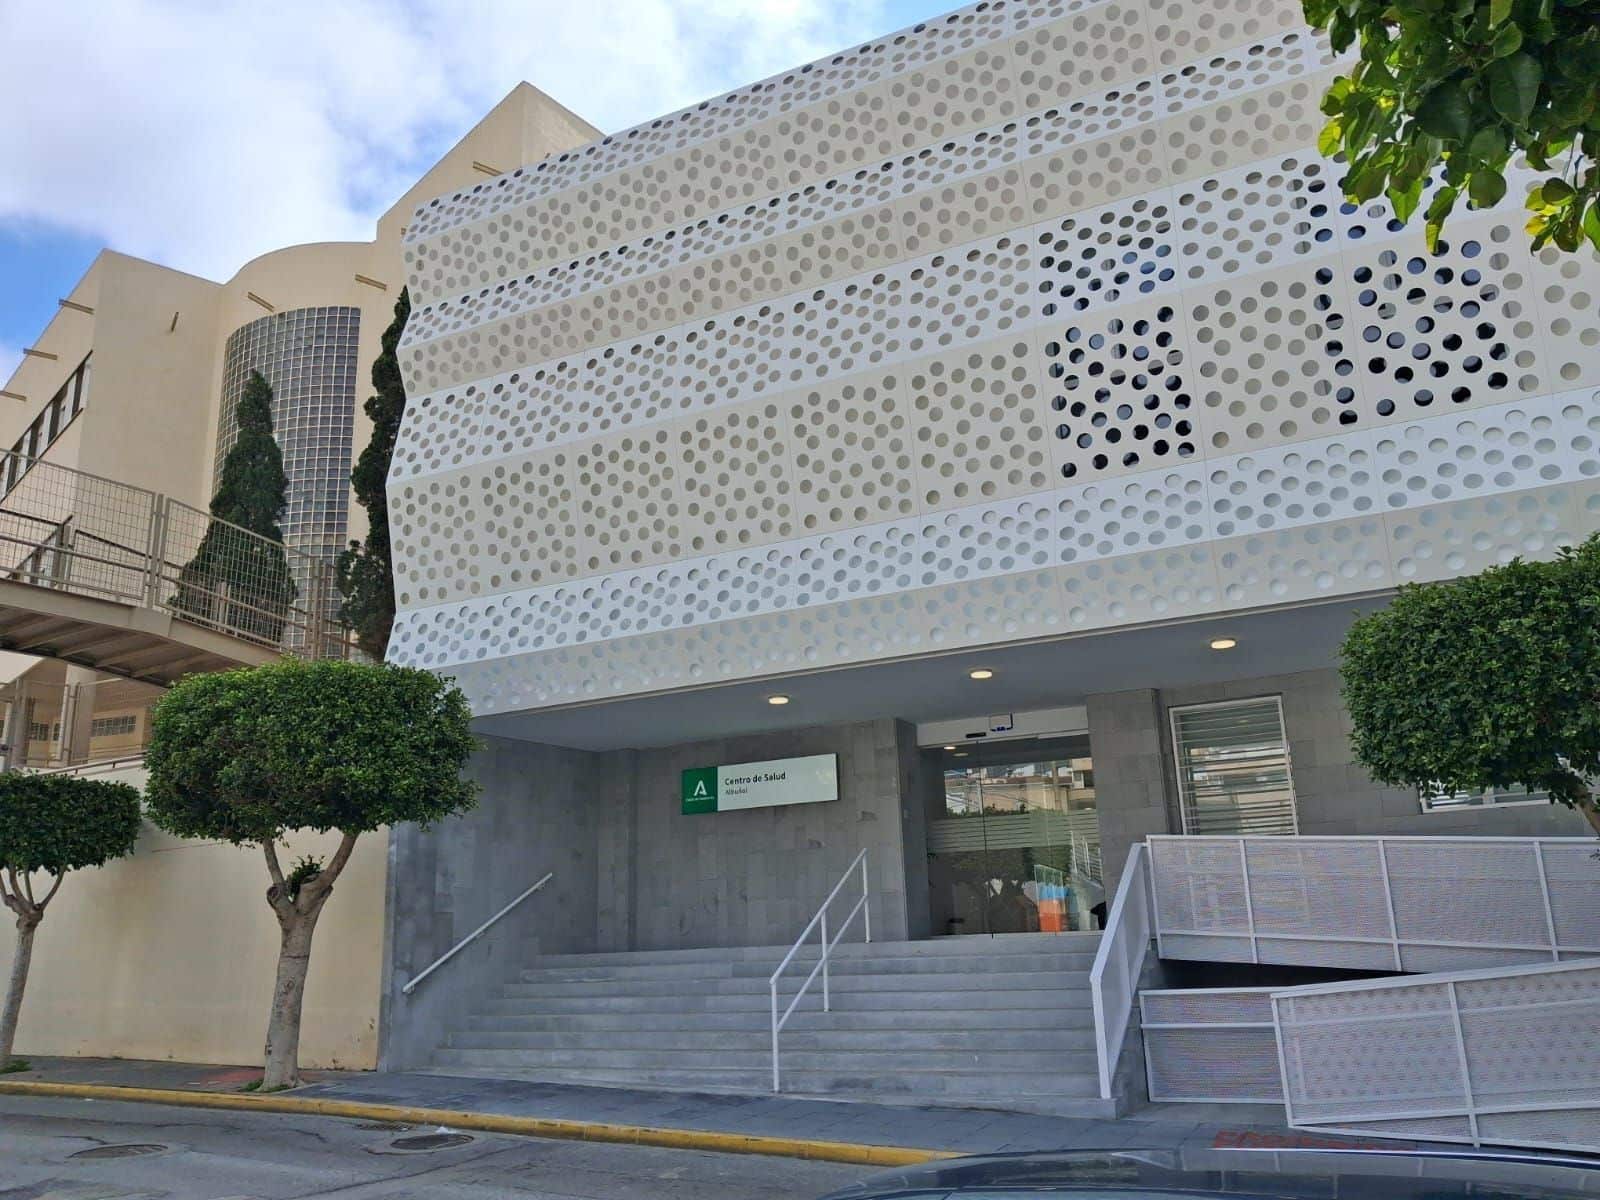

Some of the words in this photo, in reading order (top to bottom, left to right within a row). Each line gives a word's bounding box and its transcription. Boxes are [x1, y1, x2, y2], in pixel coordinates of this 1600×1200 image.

[724, 776, 751, 786] Centro
[752, 774, 762, 783] de
[763, 771, 786, 782] Salud
